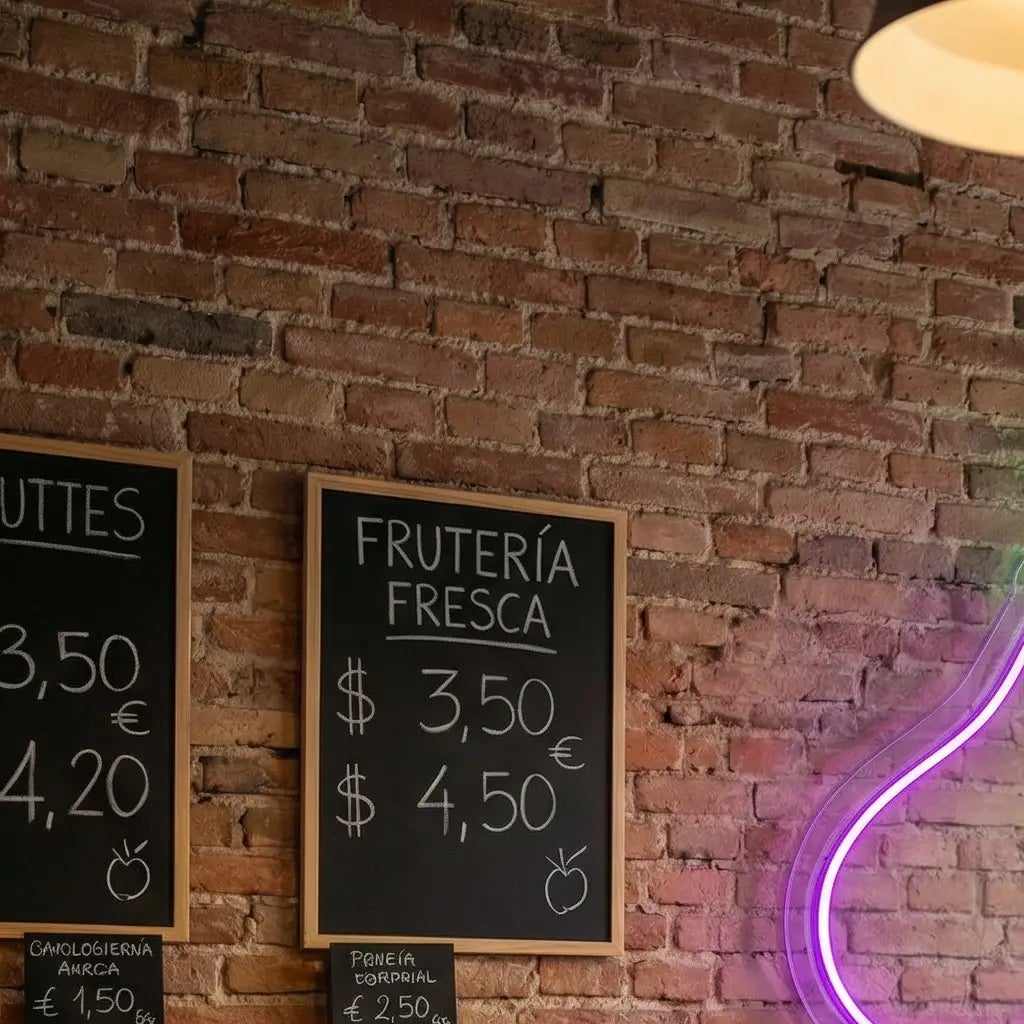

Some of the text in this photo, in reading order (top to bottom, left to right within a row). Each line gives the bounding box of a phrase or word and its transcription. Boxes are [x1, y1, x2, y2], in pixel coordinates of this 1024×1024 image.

[356, 516, 580, 588] FRUTERÍA
[387, 581, 551, 639] FRESCA
[0, 623, 140, 700] 3,50
[110, 700, 150, 735] €
[336, 657, 555, 742] $ 3,50
[0, 740, 149, 830] 4,20
[548, 736, 585, 769] €
[336, 763, 556, 842] $ 4,50
[72, 985, 135, 1021] 1,50
[374, 994, 430, 1023] 2,50
